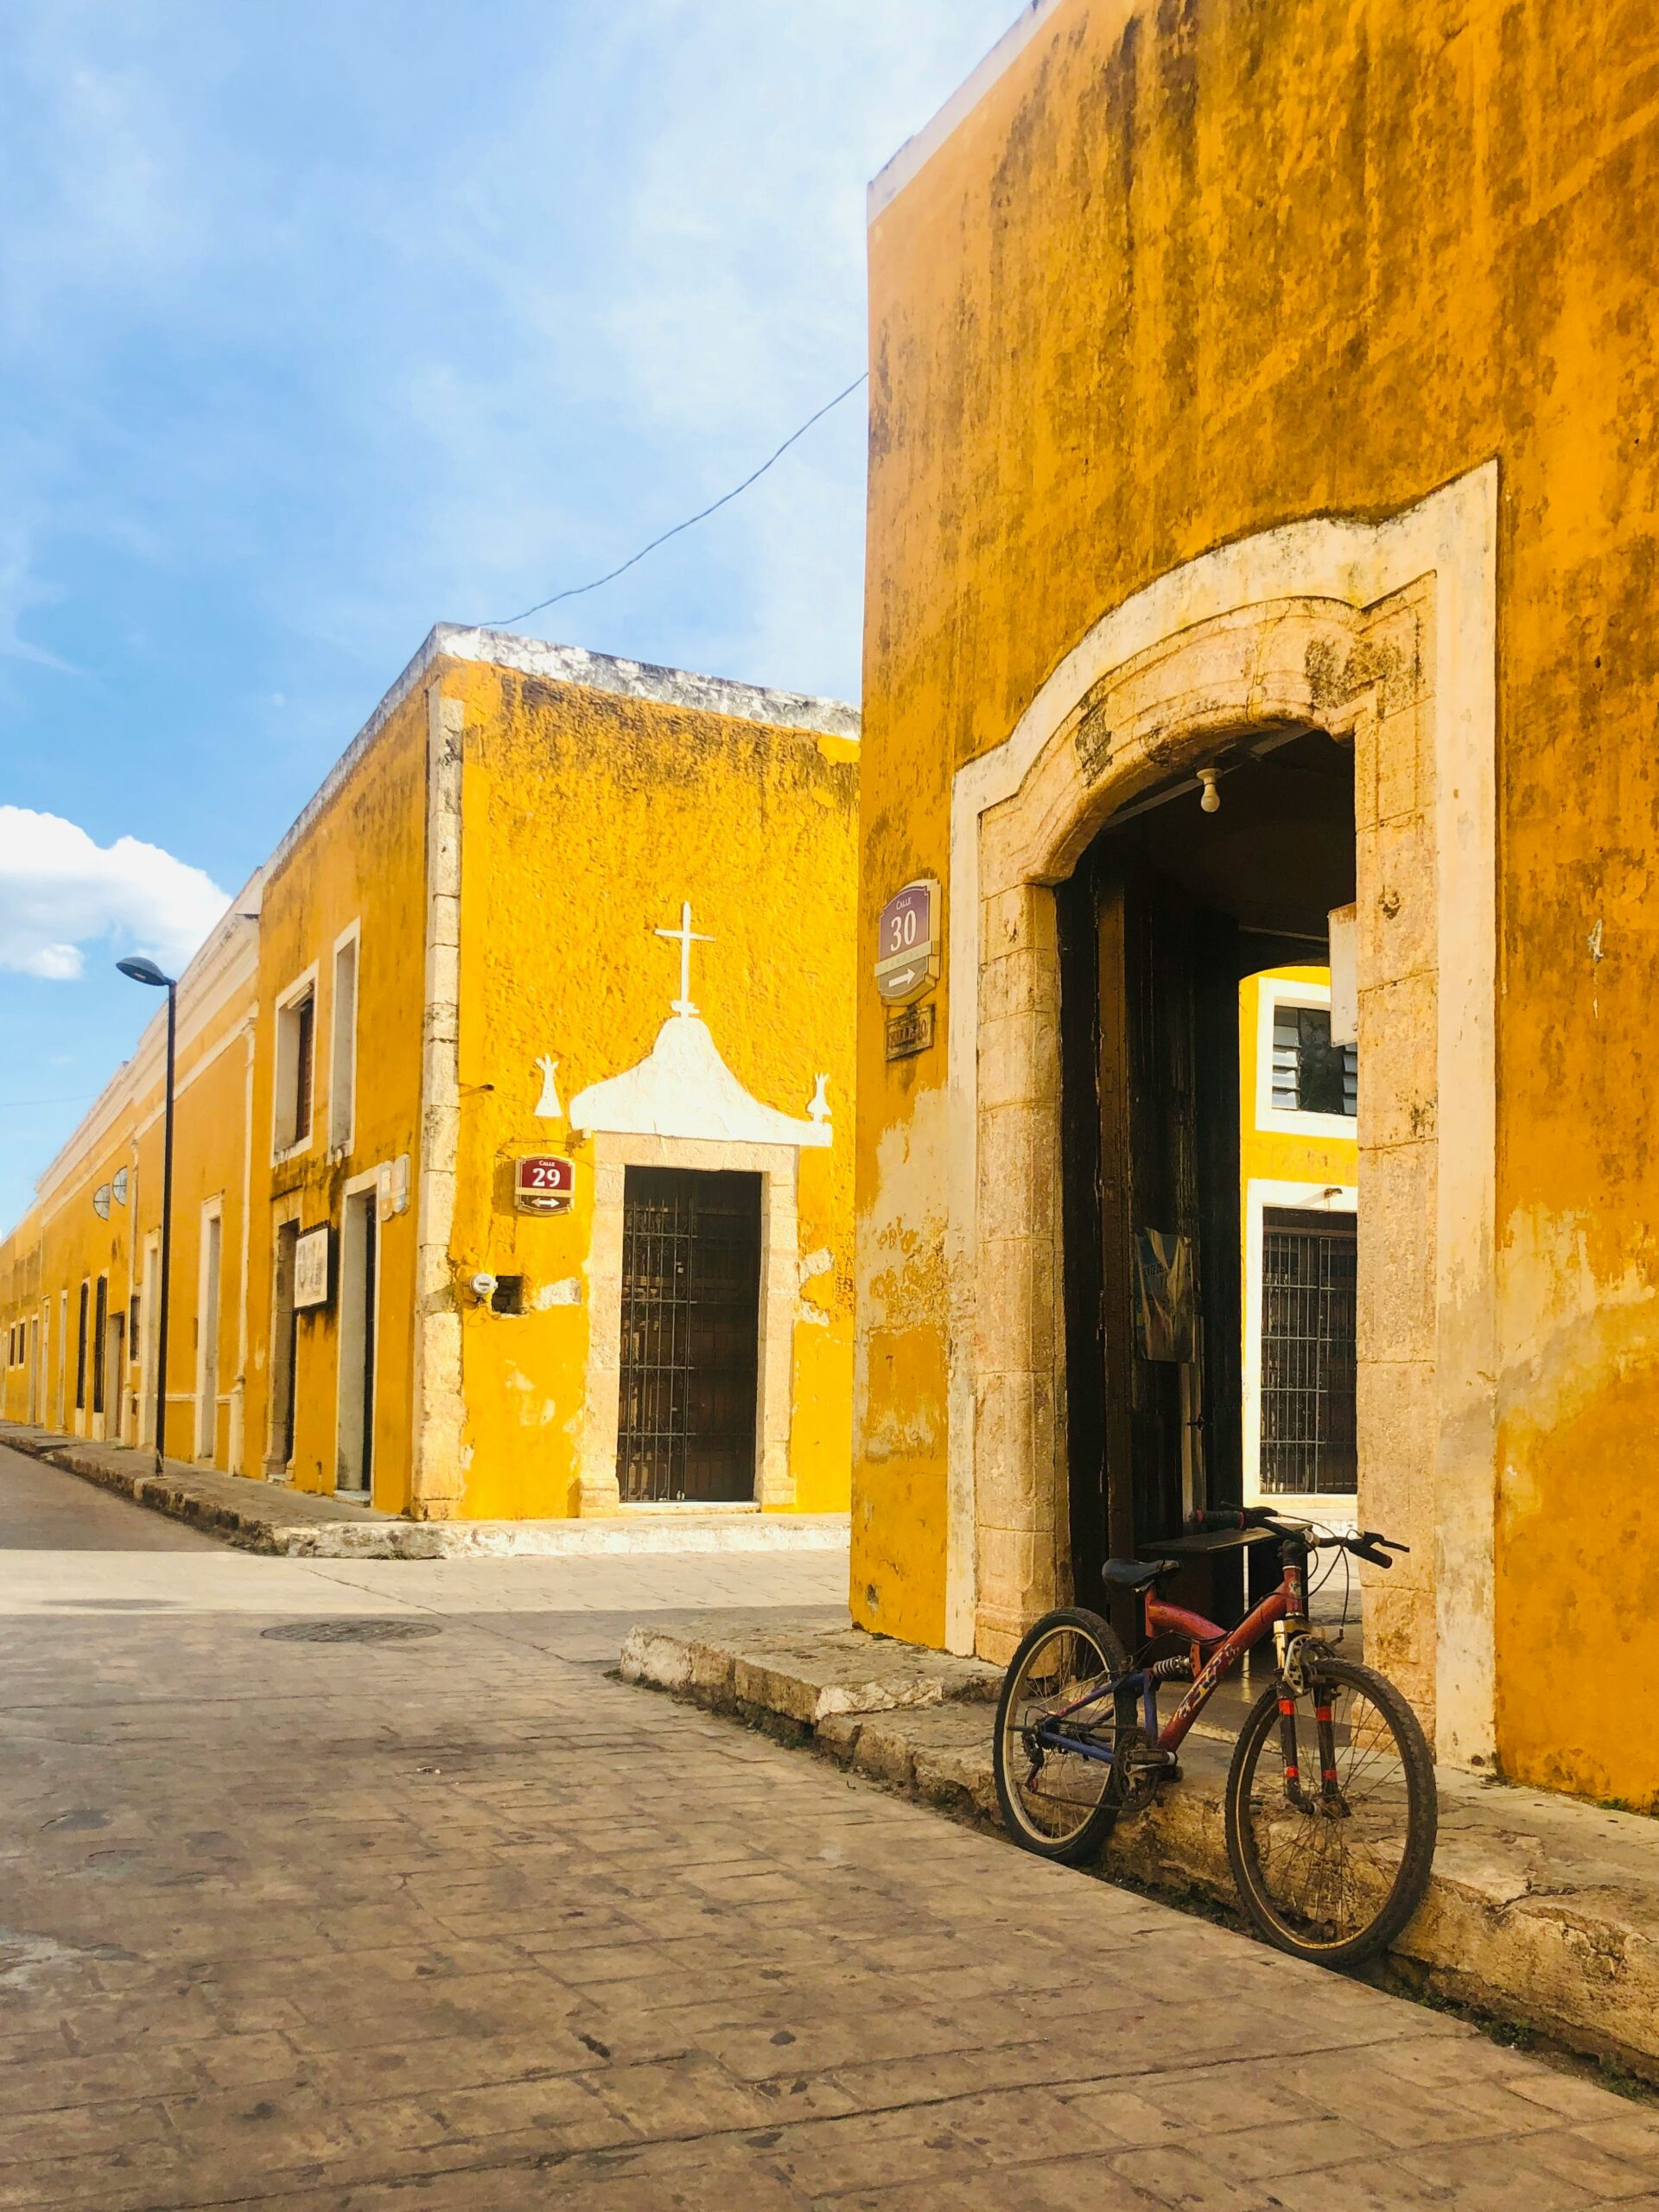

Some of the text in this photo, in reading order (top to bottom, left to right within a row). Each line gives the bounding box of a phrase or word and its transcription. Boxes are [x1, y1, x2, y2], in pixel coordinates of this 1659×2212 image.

[896, 897, 912, 910] CALLE
[890, 910, 917, 952] 30
[532, 1167, 561, 1187] 29
